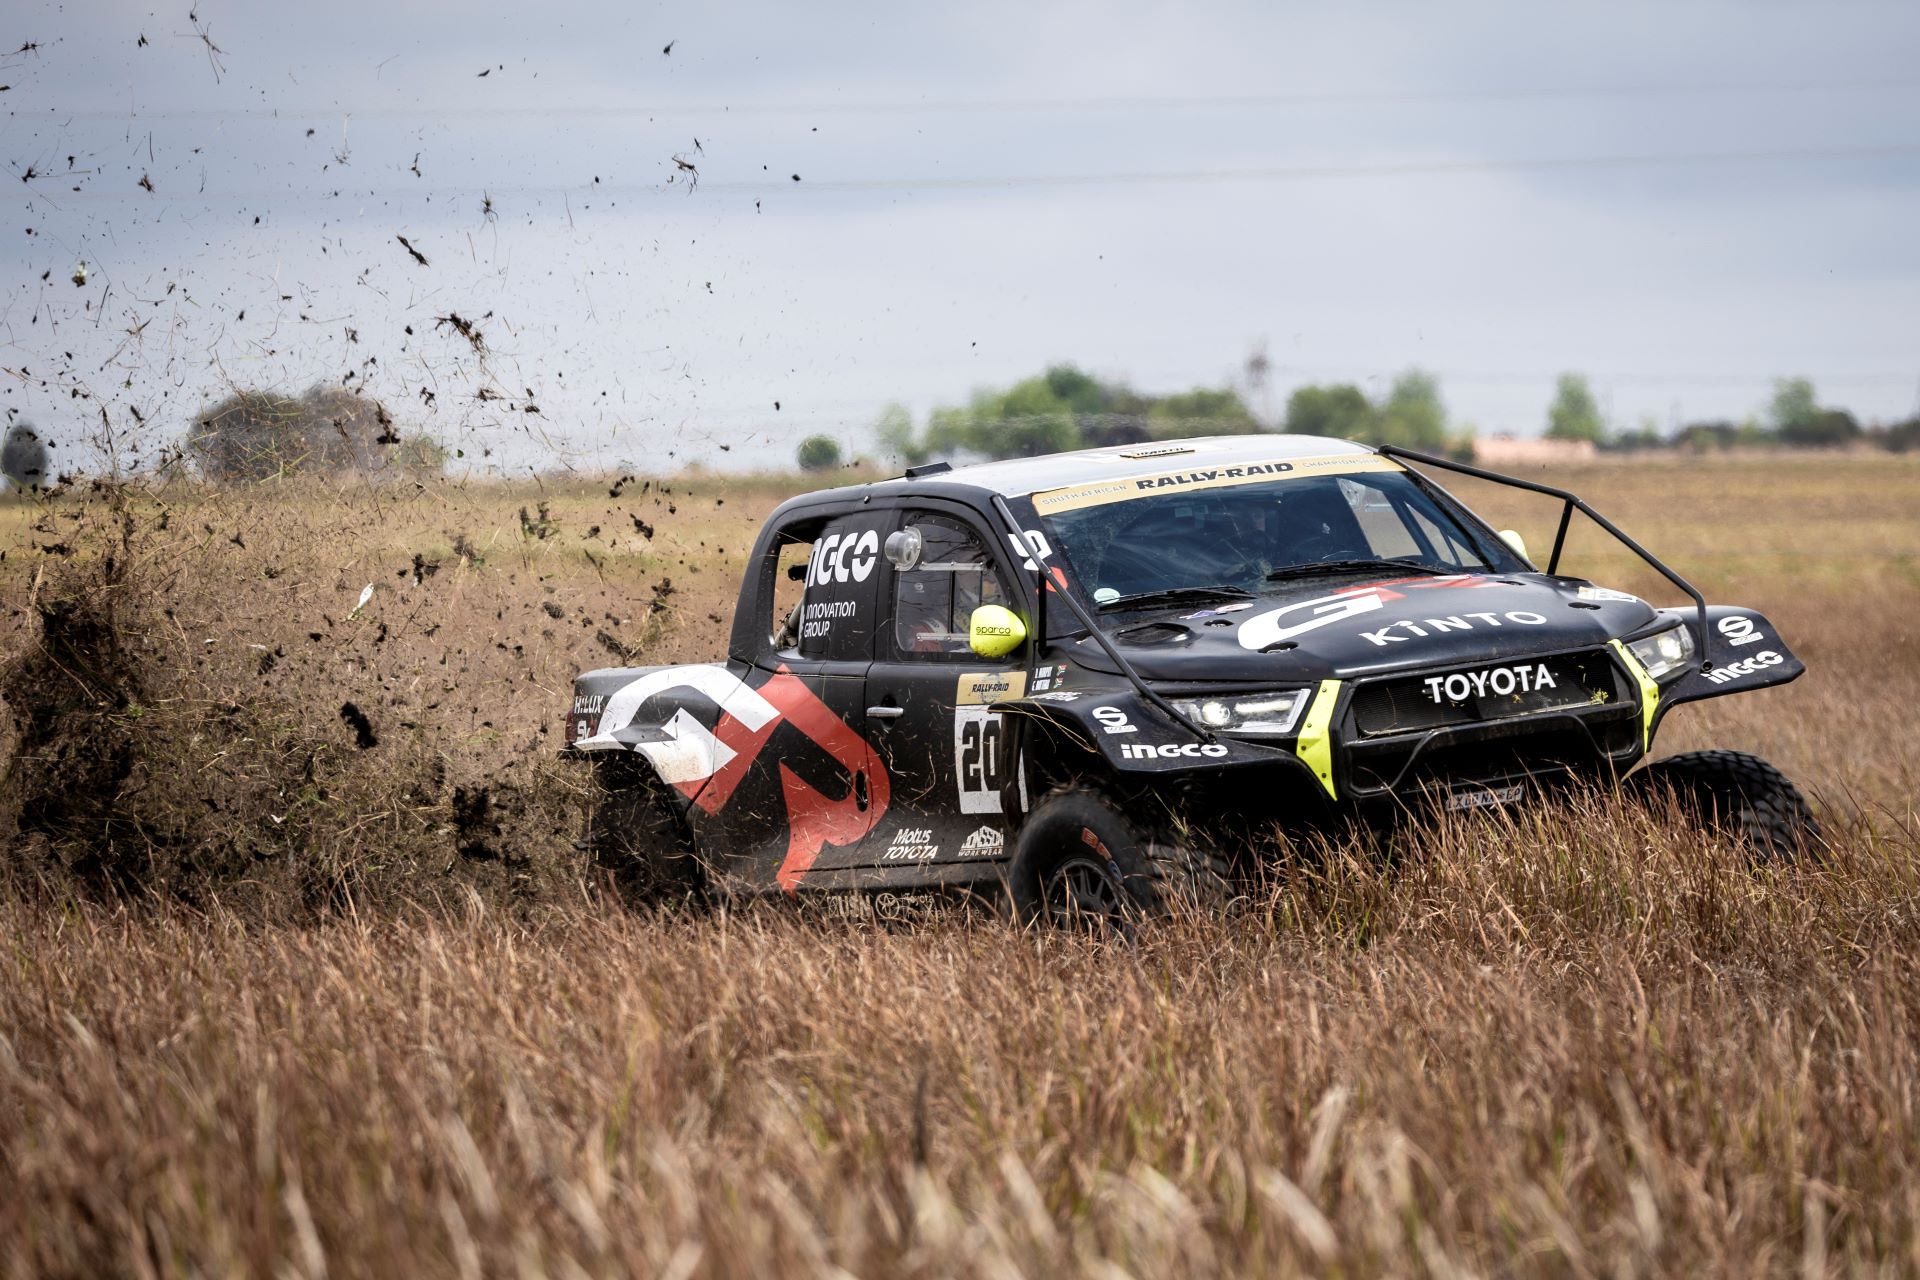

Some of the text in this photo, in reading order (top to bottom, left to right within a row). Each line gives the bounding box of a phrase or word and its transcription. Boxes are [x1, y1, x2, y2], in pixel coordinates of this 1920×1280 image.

[1136, 462, 1294, 490] RALLY-RAID
[803, 621, 831, 638] GROUP
[976, 626, 1011, 635] sparco
[971, 683, 1010, 694] RALLY-RAID
[1424, 663, 1557, 704] TOYOTA
[962, 719, 1001, 792] 20
[892, 827, 933, 845] Motus
[960, 825, 1004, 849] JONSSON
[882, 845, 939, 859] TOYOTA
